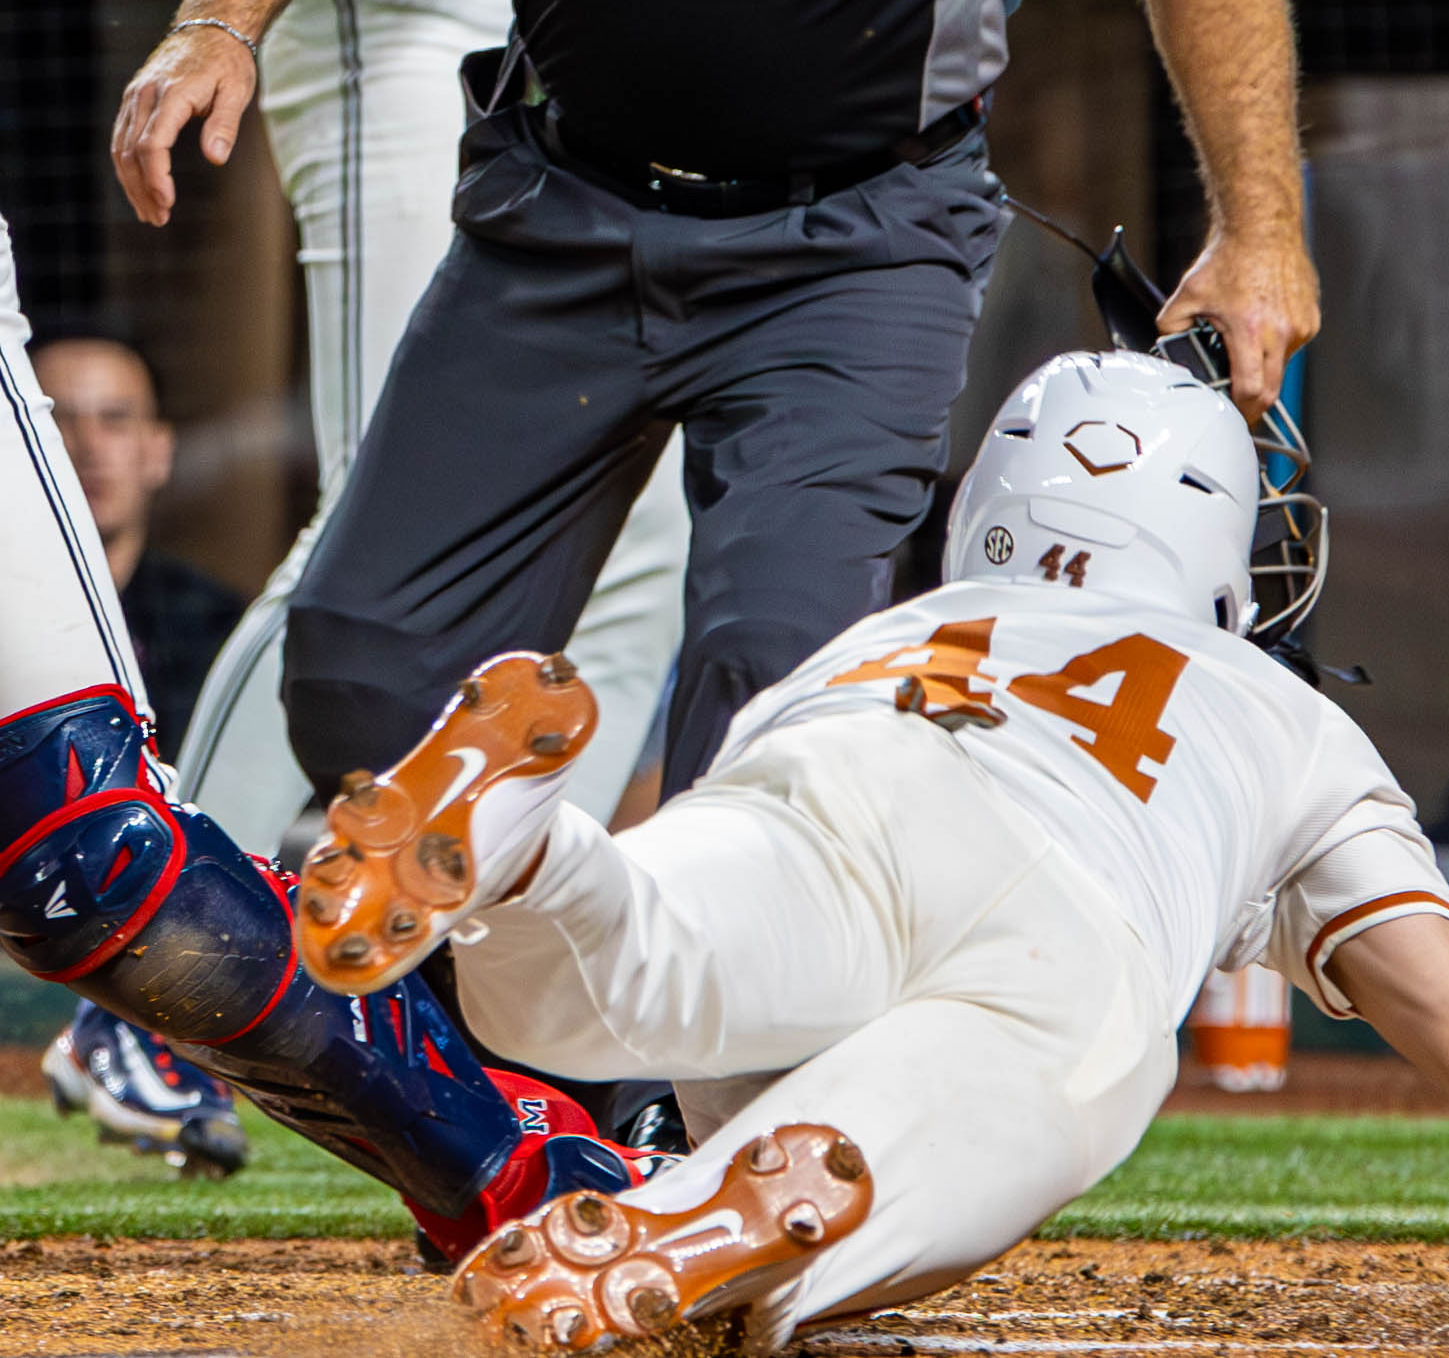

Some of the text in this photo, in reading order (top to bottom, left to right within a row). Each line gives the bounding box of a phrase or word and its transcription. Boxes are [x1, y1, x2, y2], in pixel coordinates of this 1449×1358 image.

[985, 527, 1014, 565] SEC
[1037, 542, 1091, 588] 44
[825, 616, 1191, 803] 44
[517, 1097, 550, 1135] M
